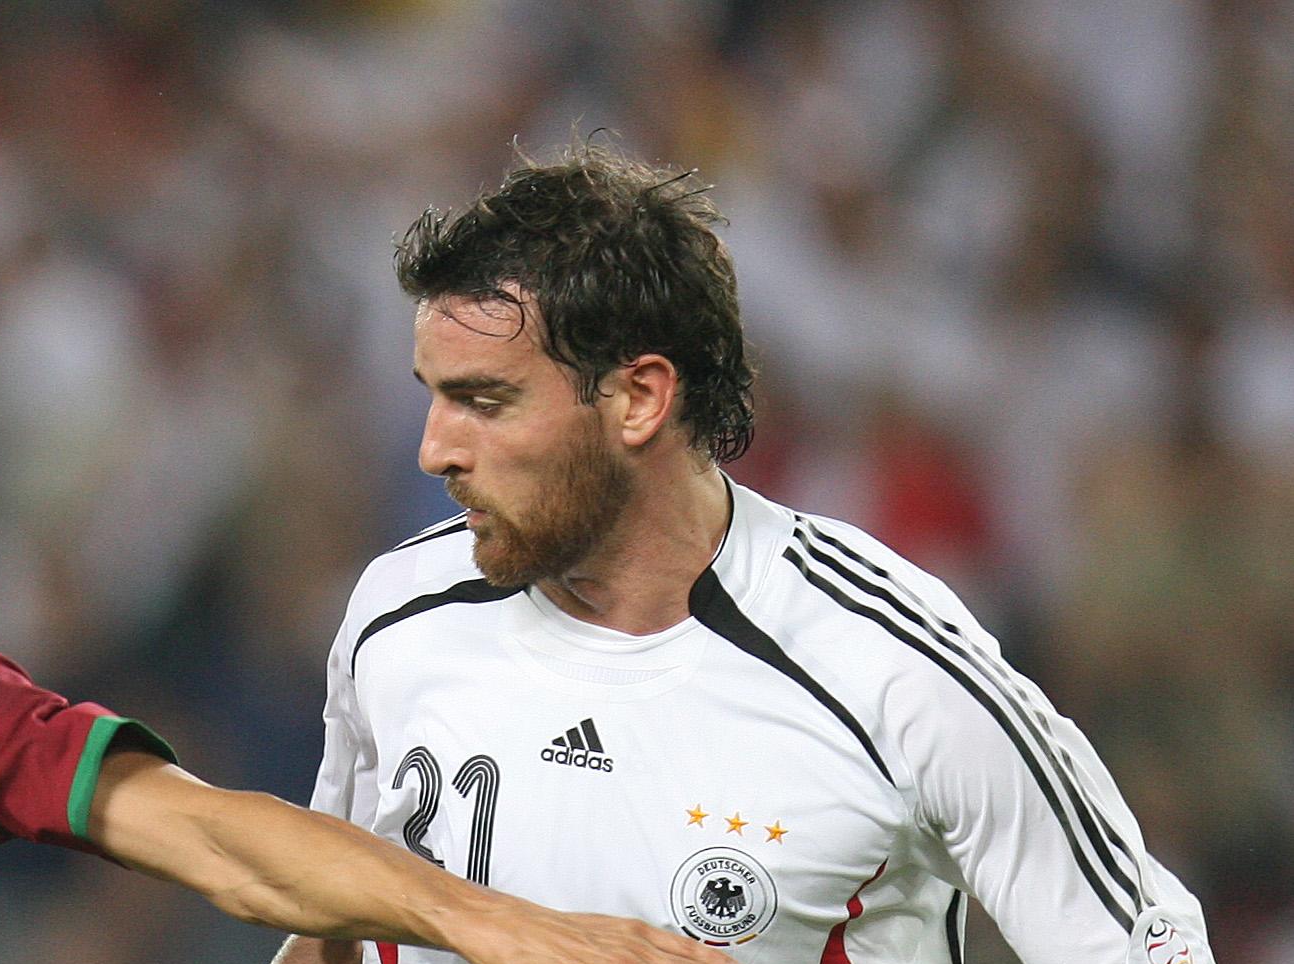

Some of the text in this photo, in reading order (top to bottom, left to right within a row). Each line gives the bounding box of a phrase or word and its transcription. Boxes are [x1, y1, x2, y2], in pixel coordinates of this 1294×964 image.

[540, 746, 613, 773] adidas
[391, 746, 501, 887] 21
[697, 860, 756, 885] DEUTSCHER
[686, 904, 757, 934] FUSSBALL-BUND
